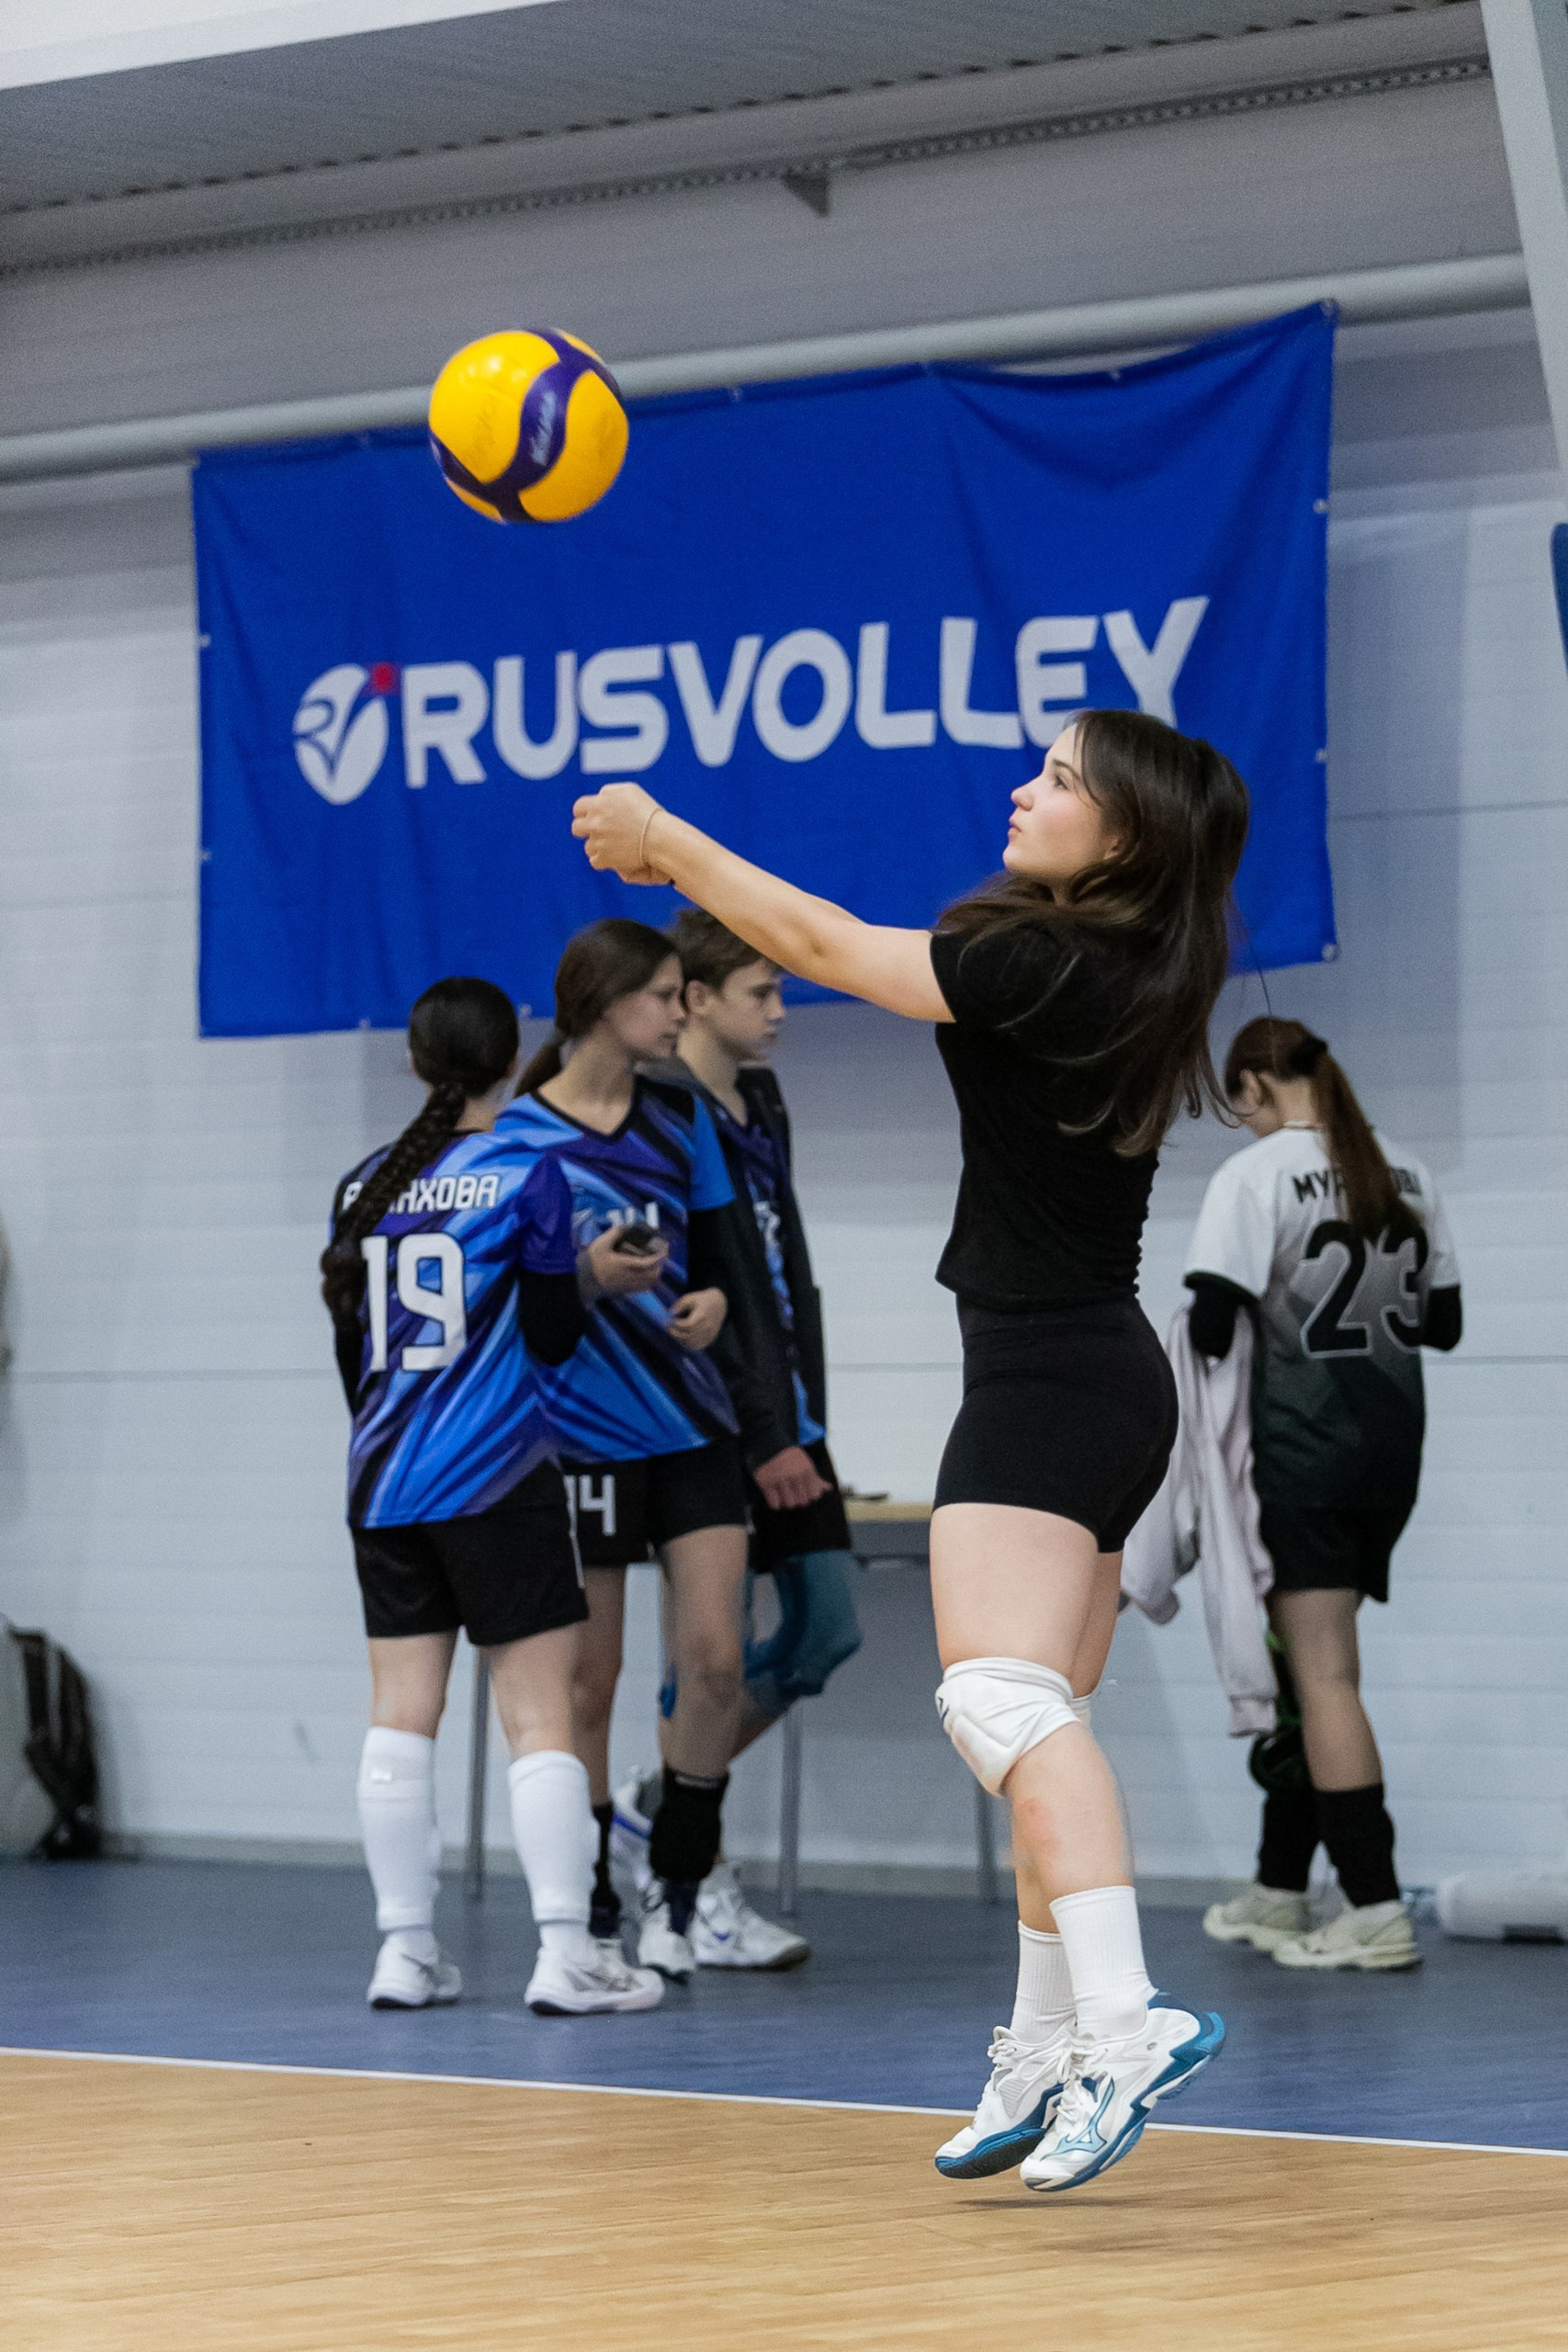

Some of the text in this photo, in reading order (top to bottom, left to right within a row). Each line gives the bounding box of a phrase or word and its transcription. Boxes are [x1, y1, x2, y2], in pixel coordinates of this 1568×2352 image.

[401, 595, 1209, 789] RUSVOLLEY
[362, 1233, 467, 1372] 19
[1301, 1218, 1428, 1360] 23
